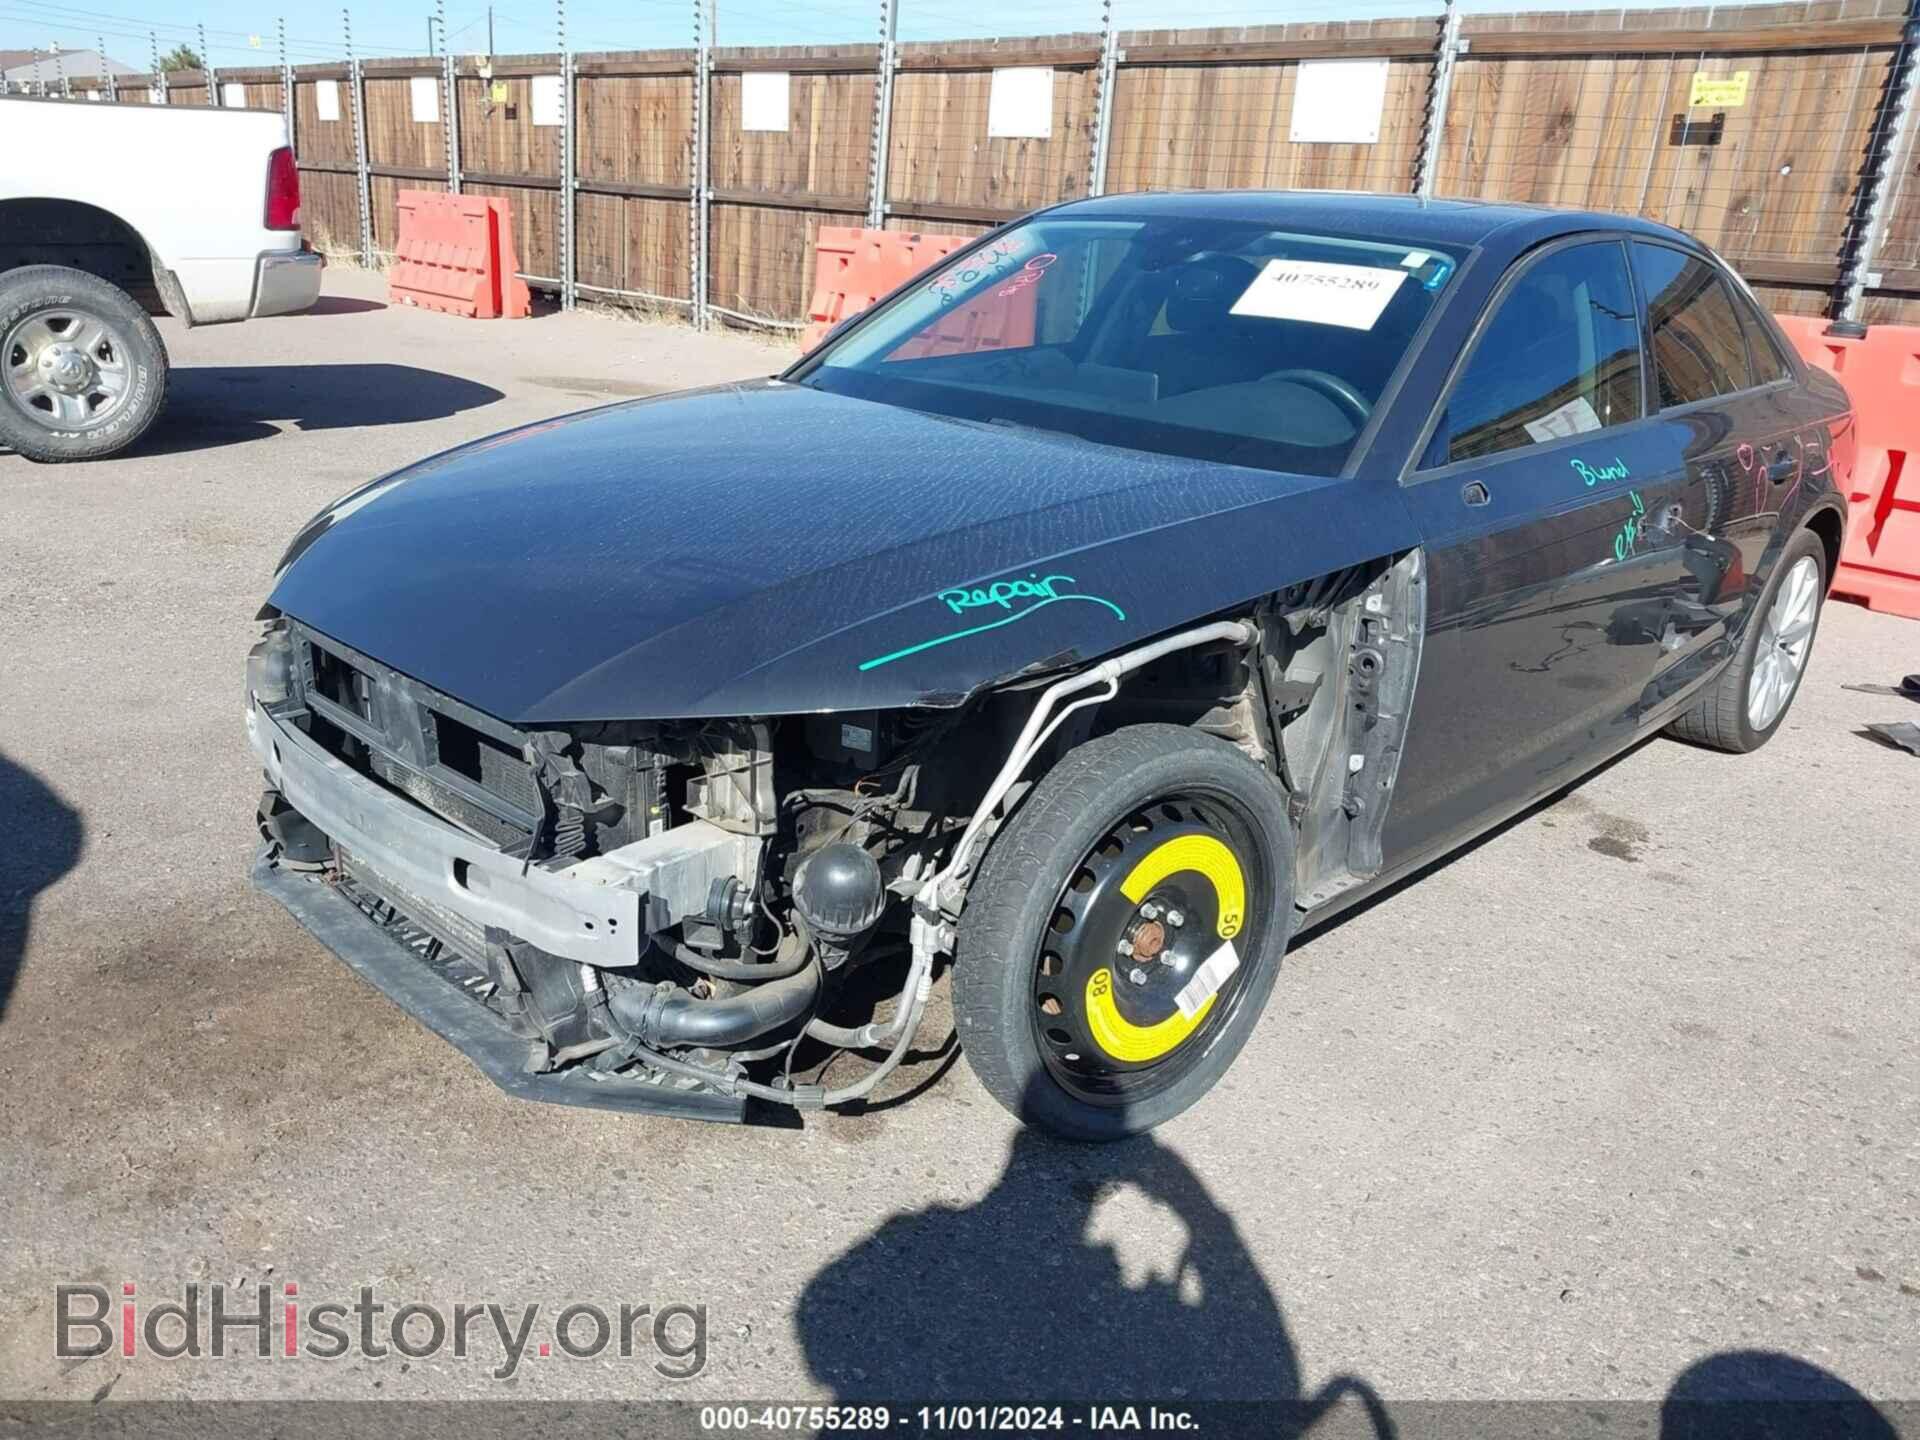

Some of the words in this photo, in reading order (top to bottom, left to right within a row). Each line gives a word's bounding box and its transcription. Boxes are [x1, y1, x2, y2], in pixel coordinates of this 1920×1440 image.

[1271, 270, 1381, 292] 40755289
[937, 573, 1076, 614] Repair
[1221, 912, 1240, 938] 50
